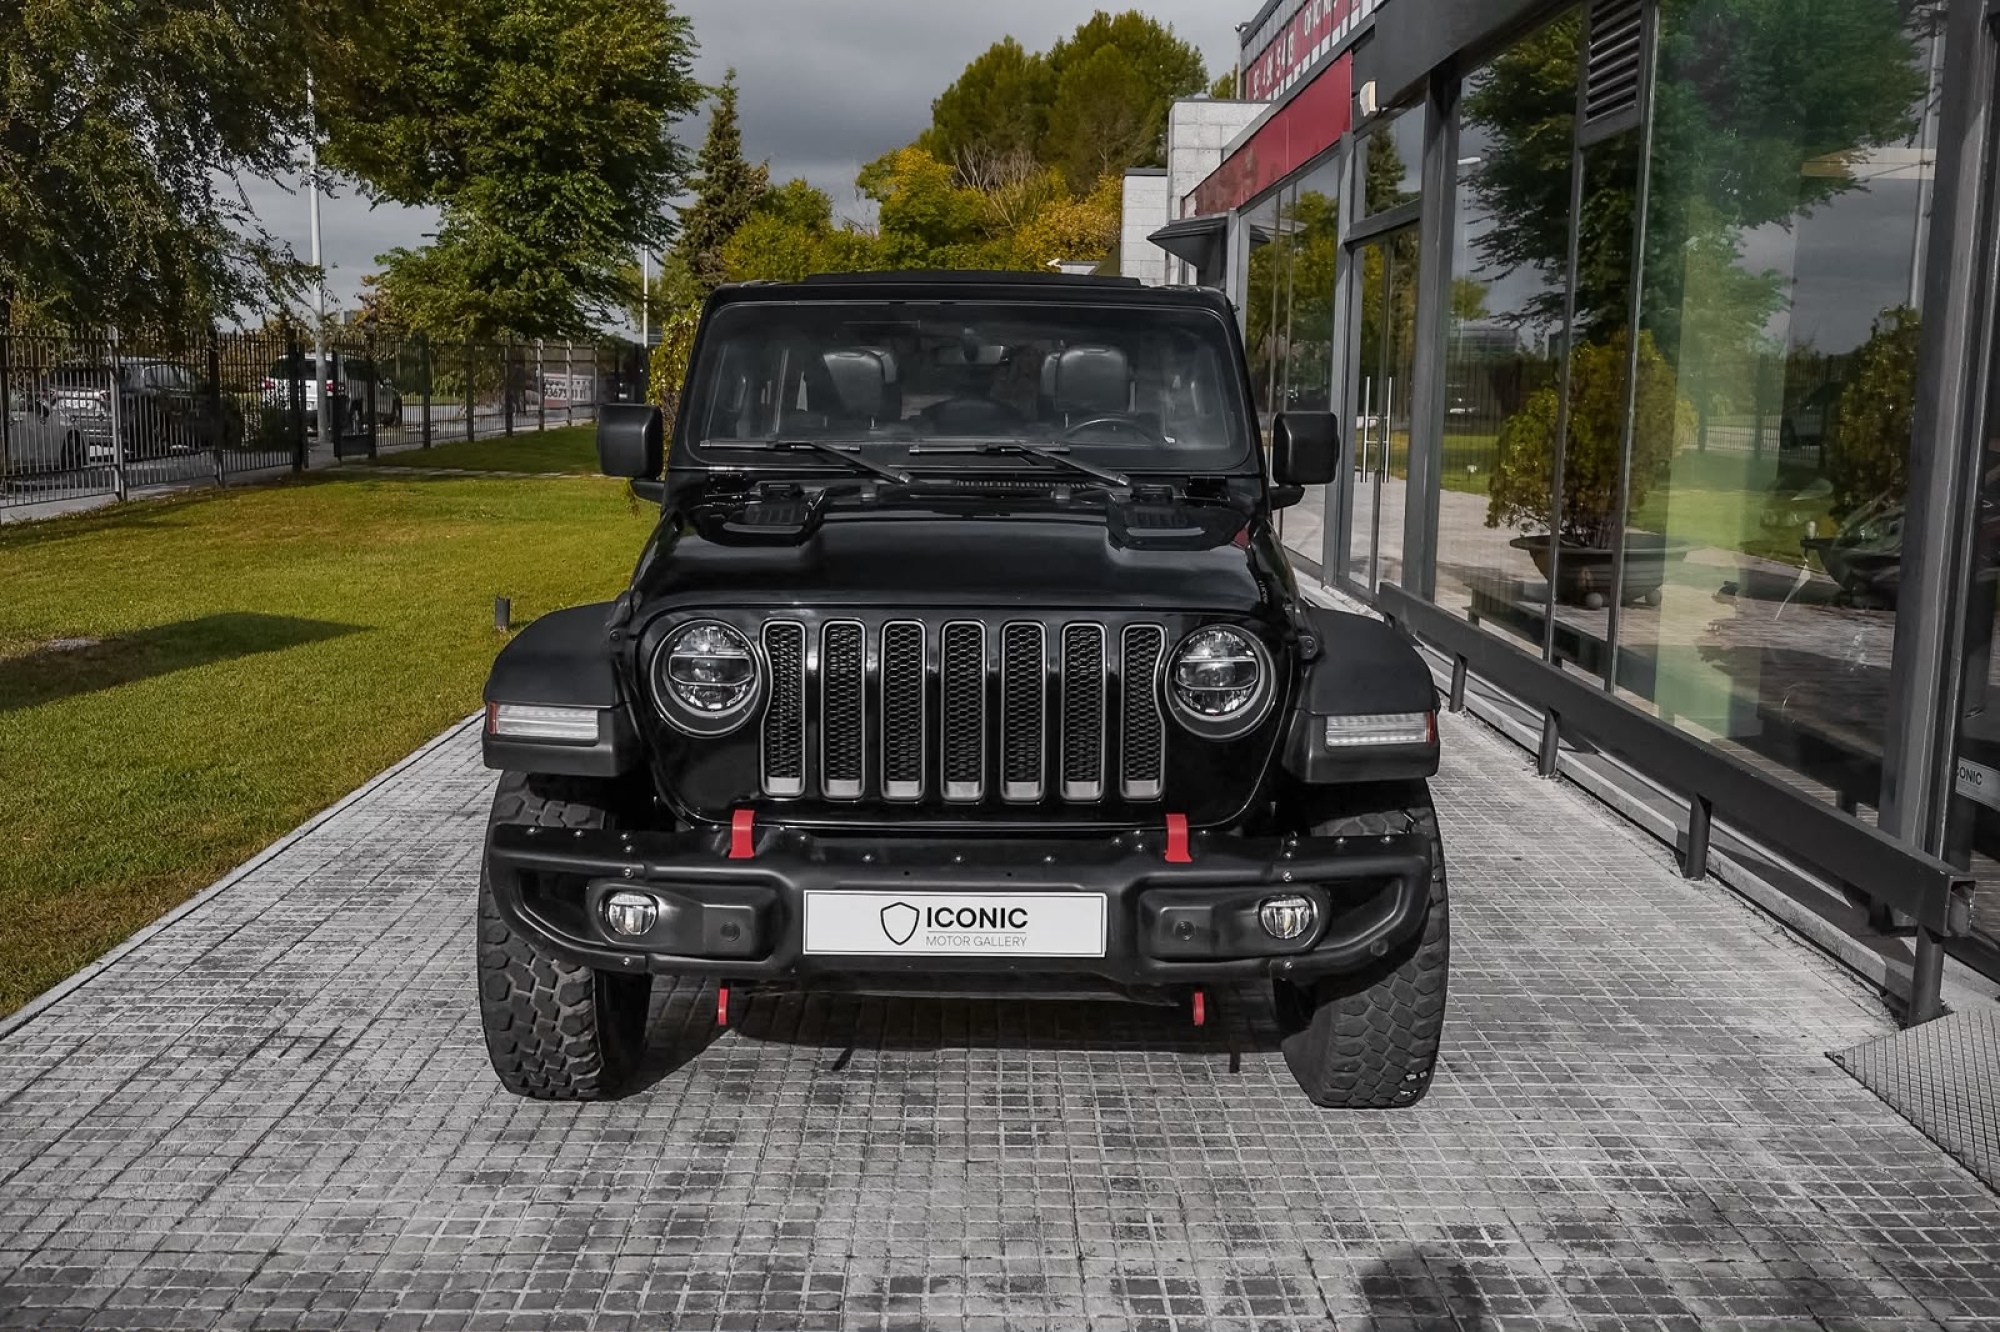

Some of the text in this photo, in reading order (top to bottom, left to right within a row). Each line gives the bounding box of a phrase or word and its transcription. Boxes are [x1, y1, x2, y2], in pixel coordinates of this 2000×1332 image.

[1957, 766, 1982, 786] ONIC
[926, 906, 1028, 929] ICONIC
[925, 935, 1028, 947] MOTOR GALLERY
